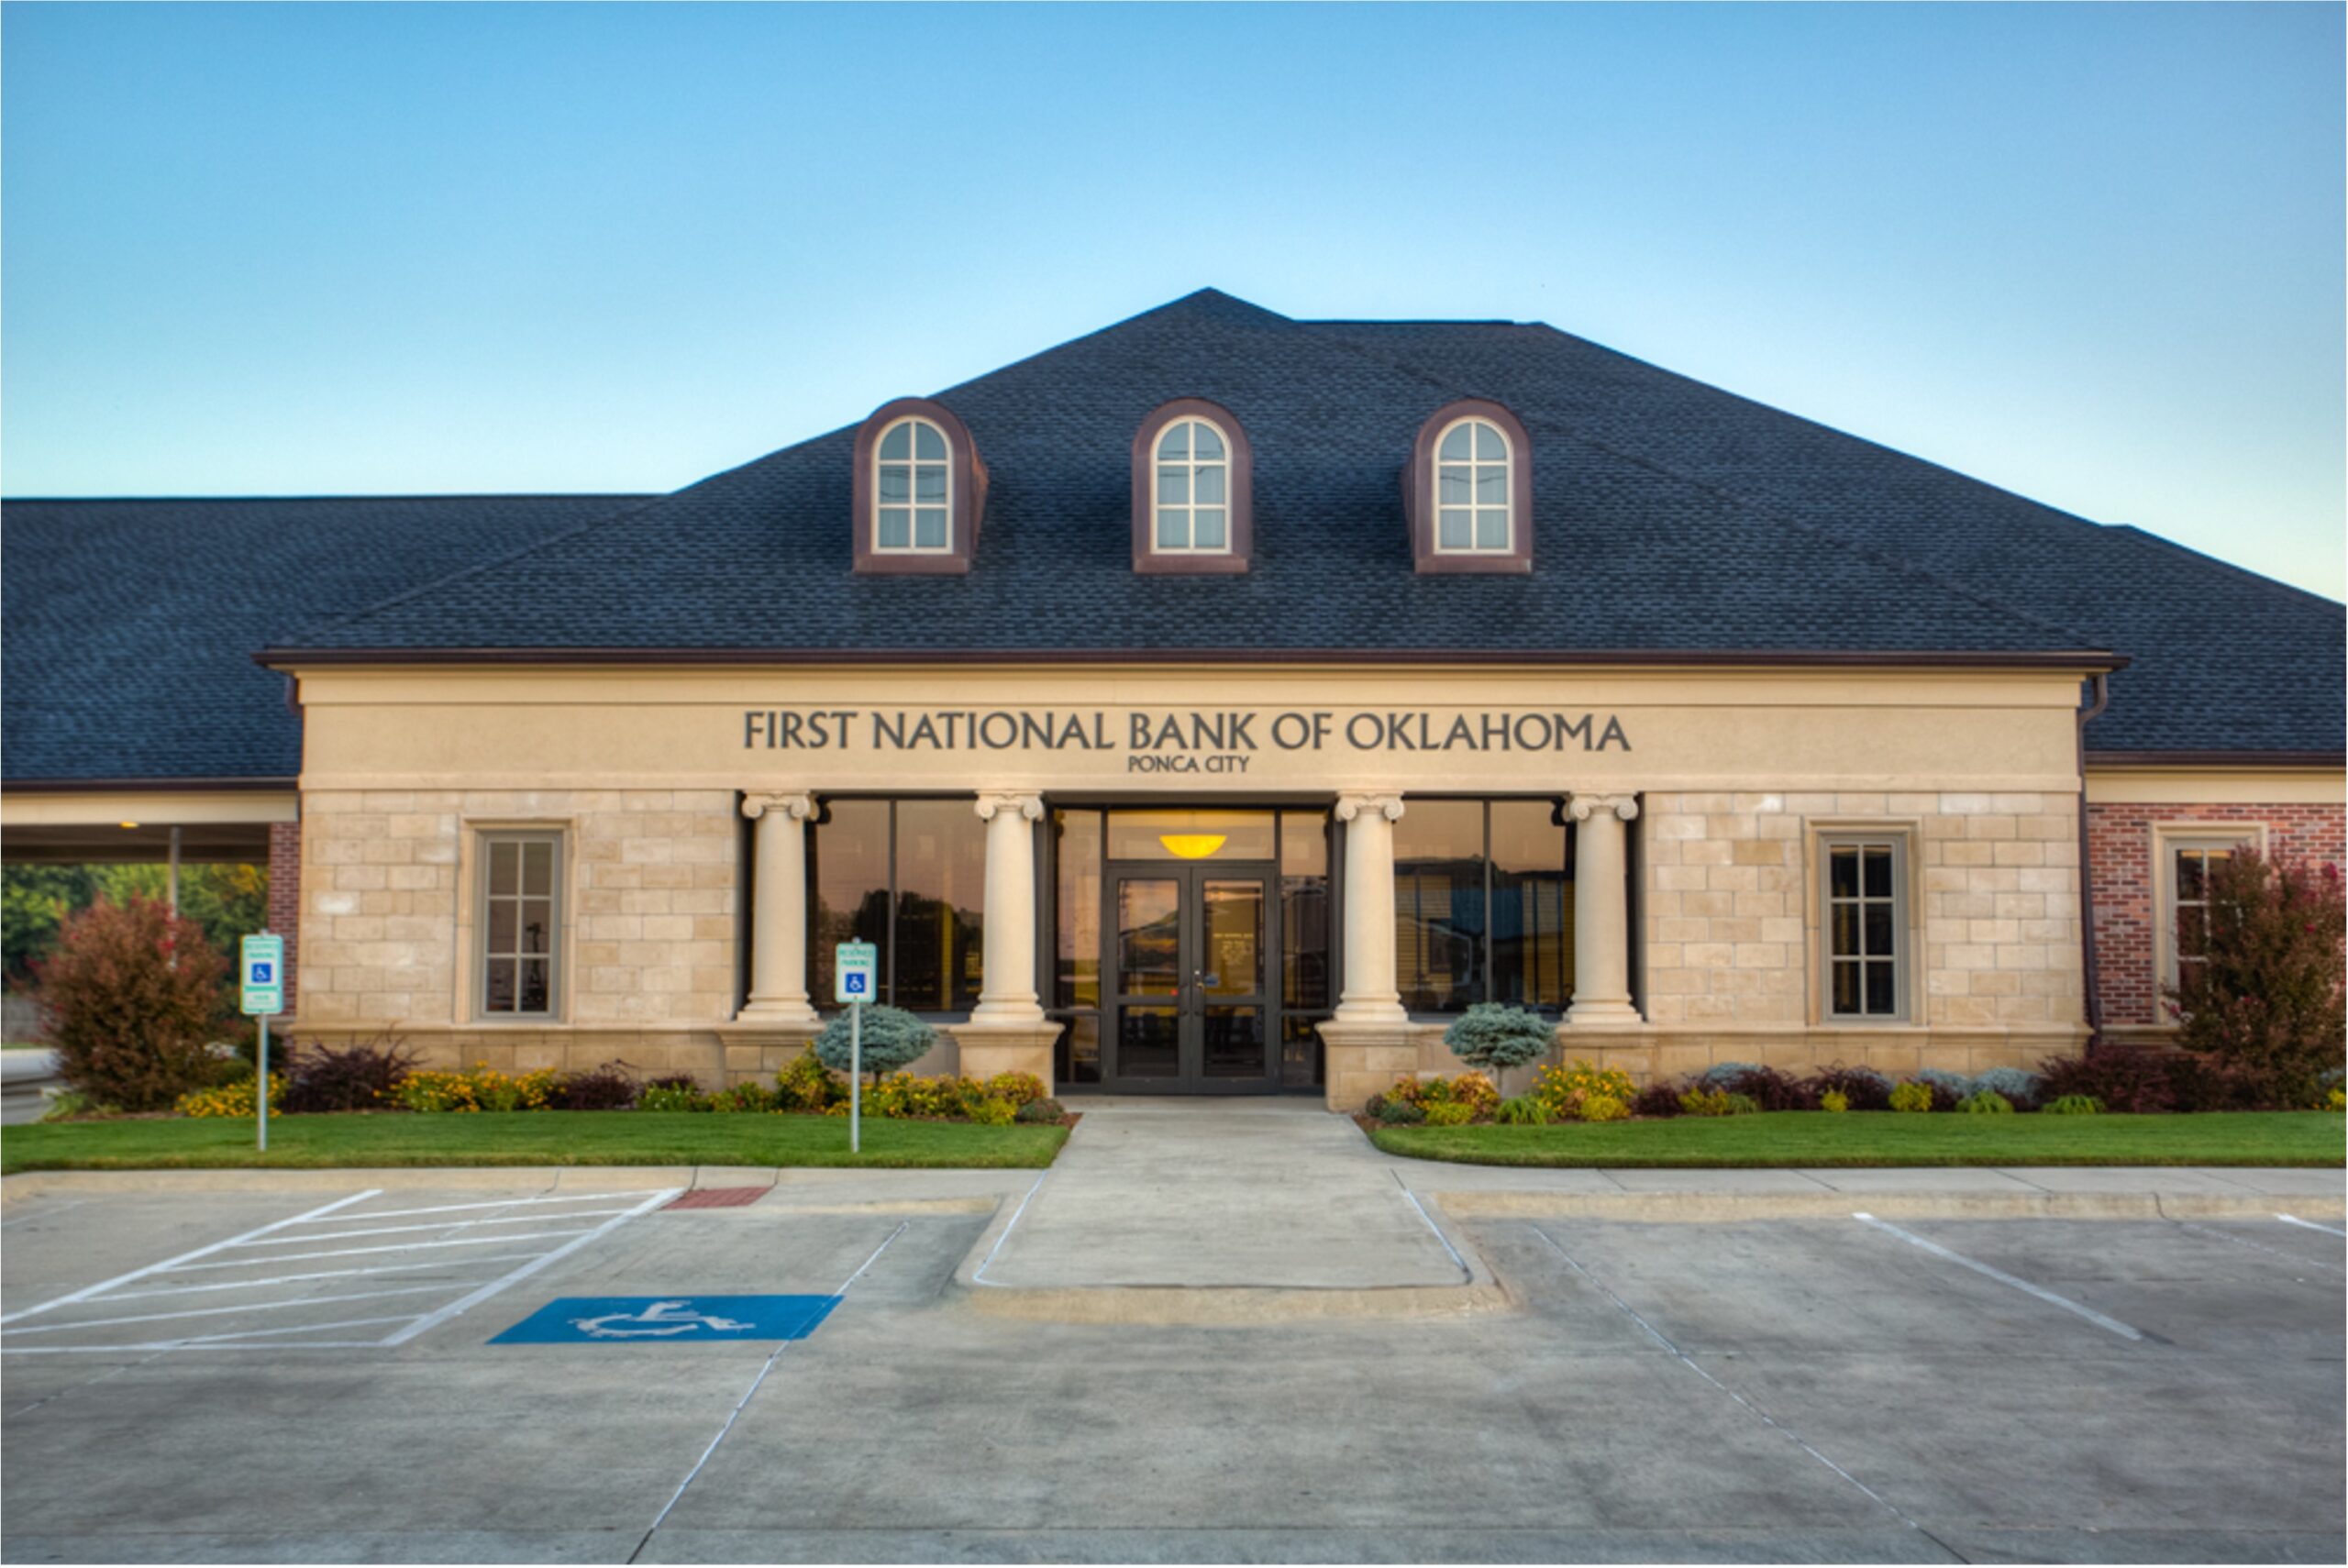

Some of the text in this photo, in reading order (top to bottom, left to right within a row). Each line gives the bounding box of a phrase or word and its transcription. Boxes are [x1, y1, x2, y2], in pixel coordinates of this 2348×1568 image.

[744, 712, 1633, 751] FIRST NATIONAL BANK OF OKLAHOMA
[1128, 756, 1250, 772] PONCA CITY
